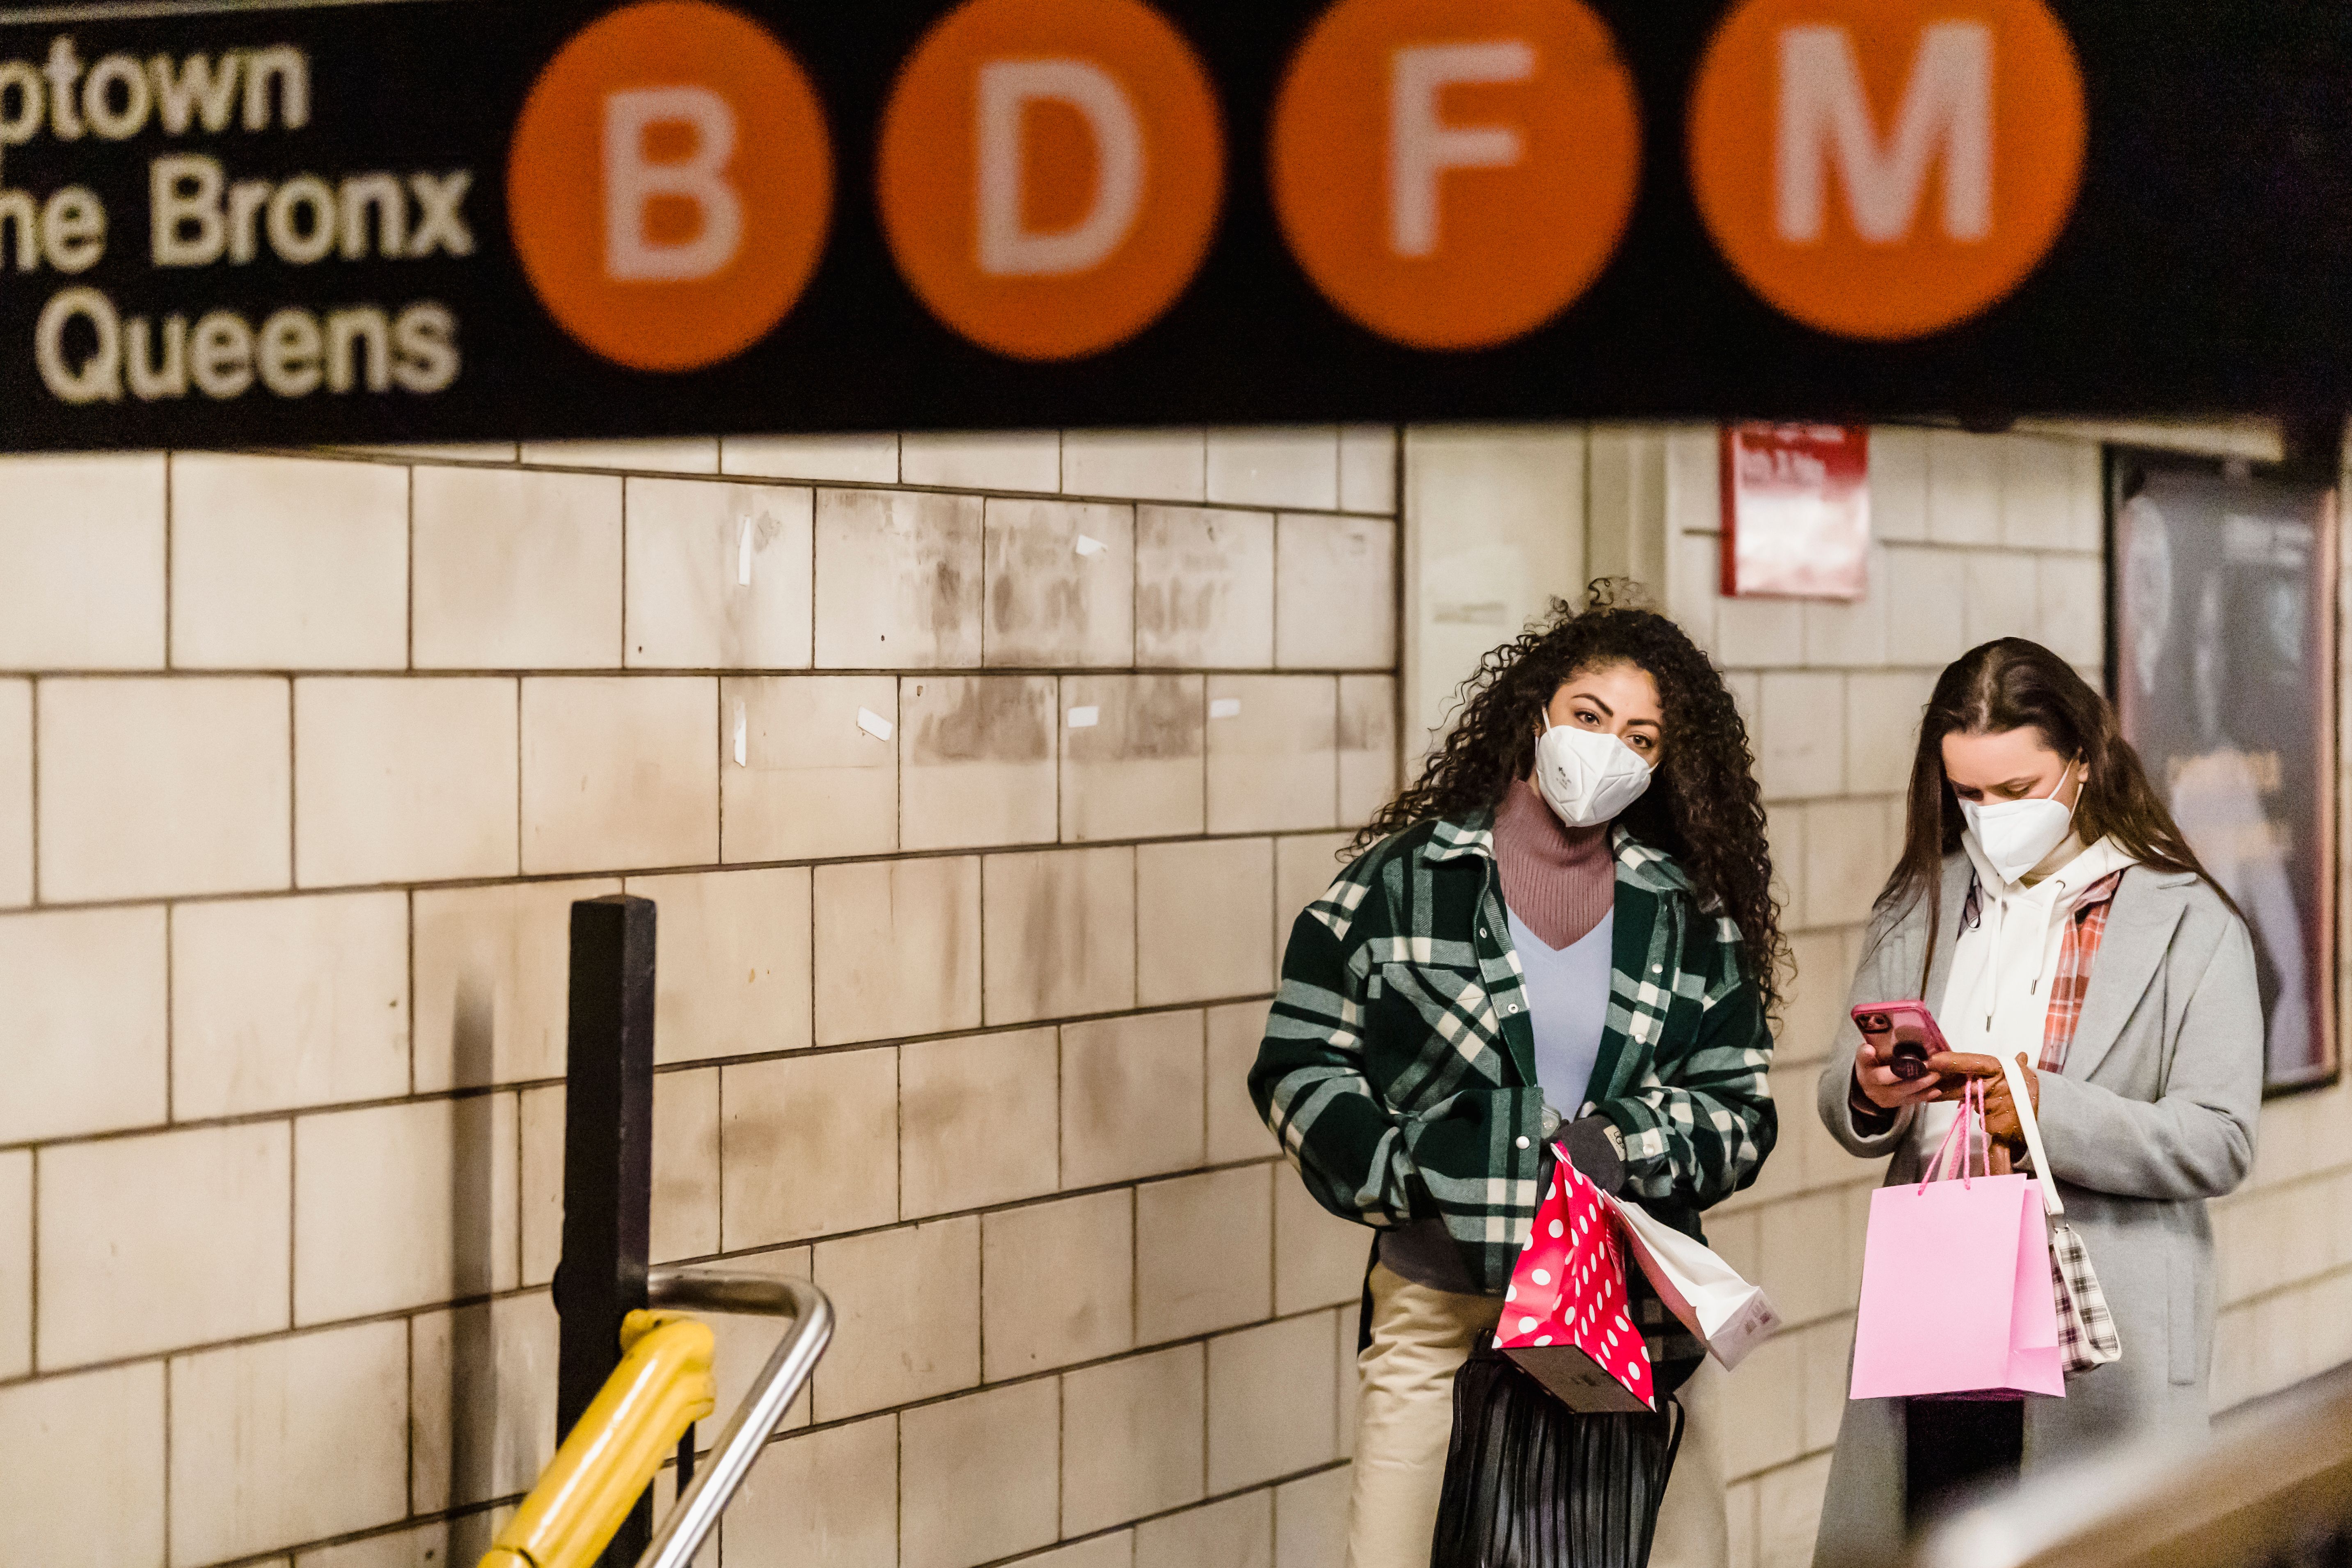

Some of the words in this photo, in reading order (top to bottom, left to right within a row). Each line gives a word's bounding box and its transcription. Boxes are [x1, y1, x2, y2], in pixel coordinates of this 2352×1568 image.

[607, 88, 739, 278] B
[981, 62, 1140, 272] D
[1393, 43, 1532, 253] F
[1778, 22, 1991, 240] M
[151, 155, 471, 265] Bronx
[36, 287, 457, 403] Queens
